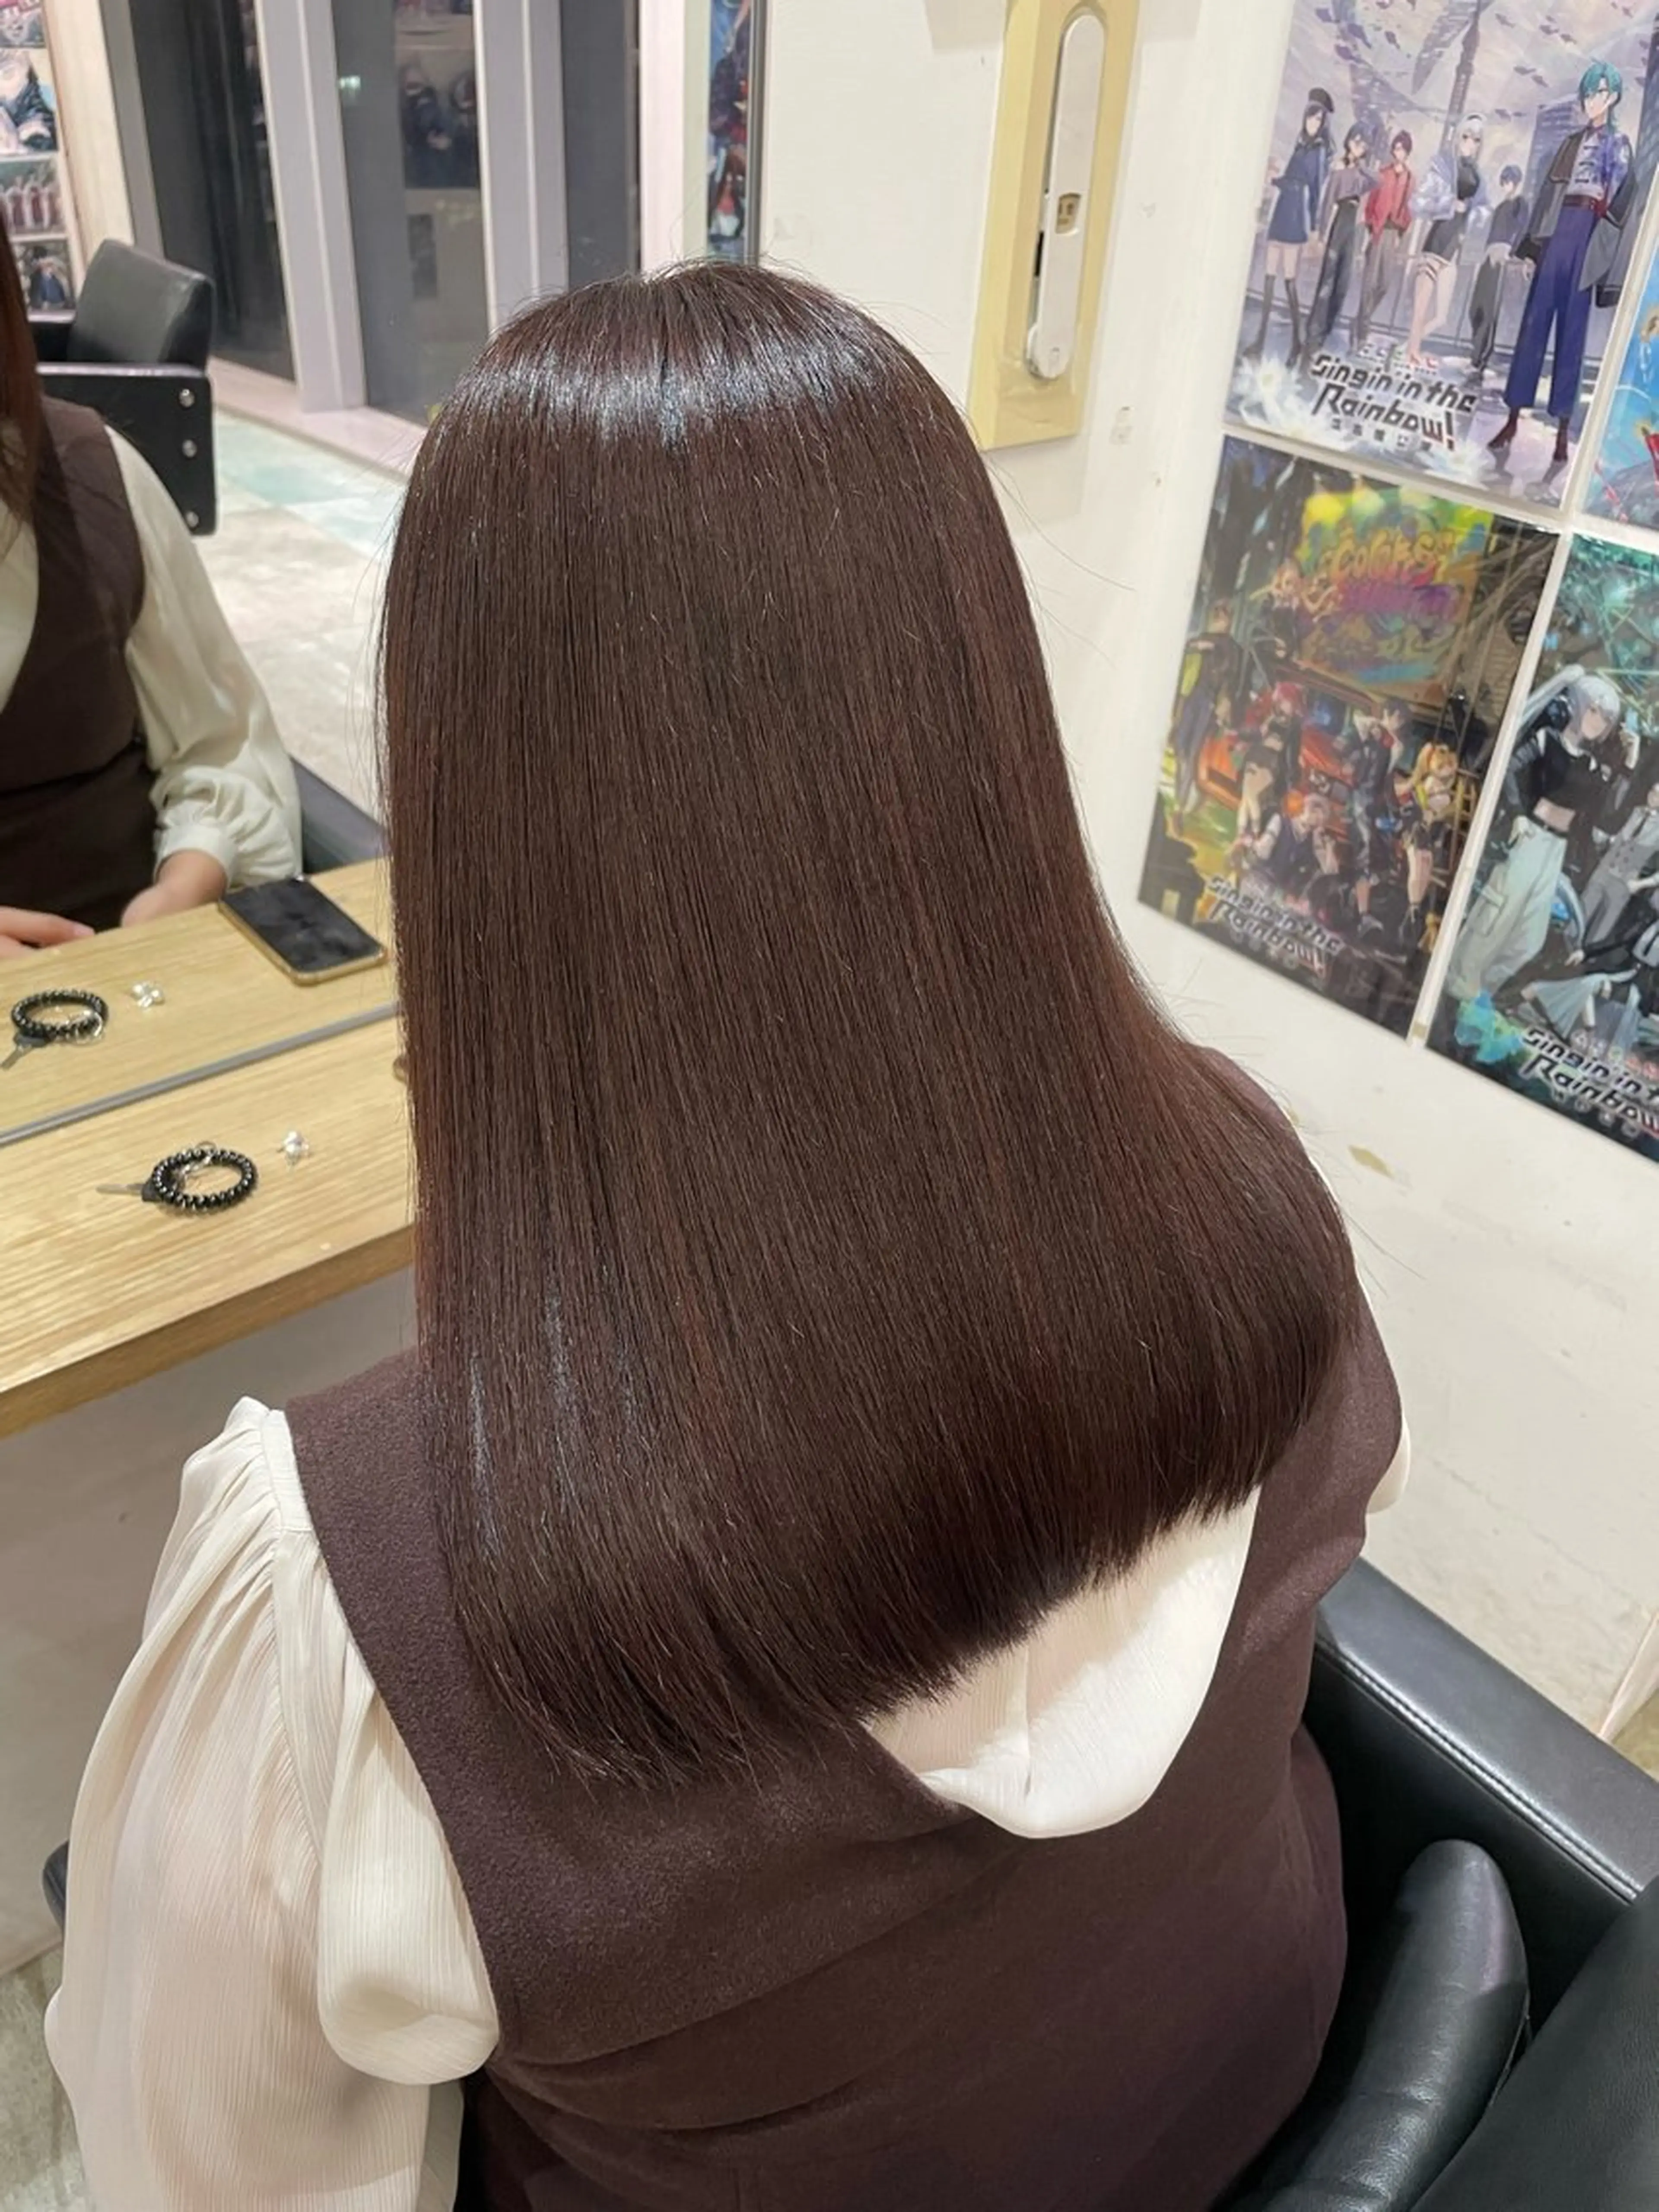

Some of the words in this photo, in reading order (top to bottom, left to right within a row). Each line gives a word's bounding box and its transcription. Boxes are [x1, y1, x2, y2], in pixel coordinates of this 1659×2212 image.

[1311, 383, 1456, 451] Rainbow!
[1397, 373, 1424, 399] in
[1425, 380, 1478, 413] the
